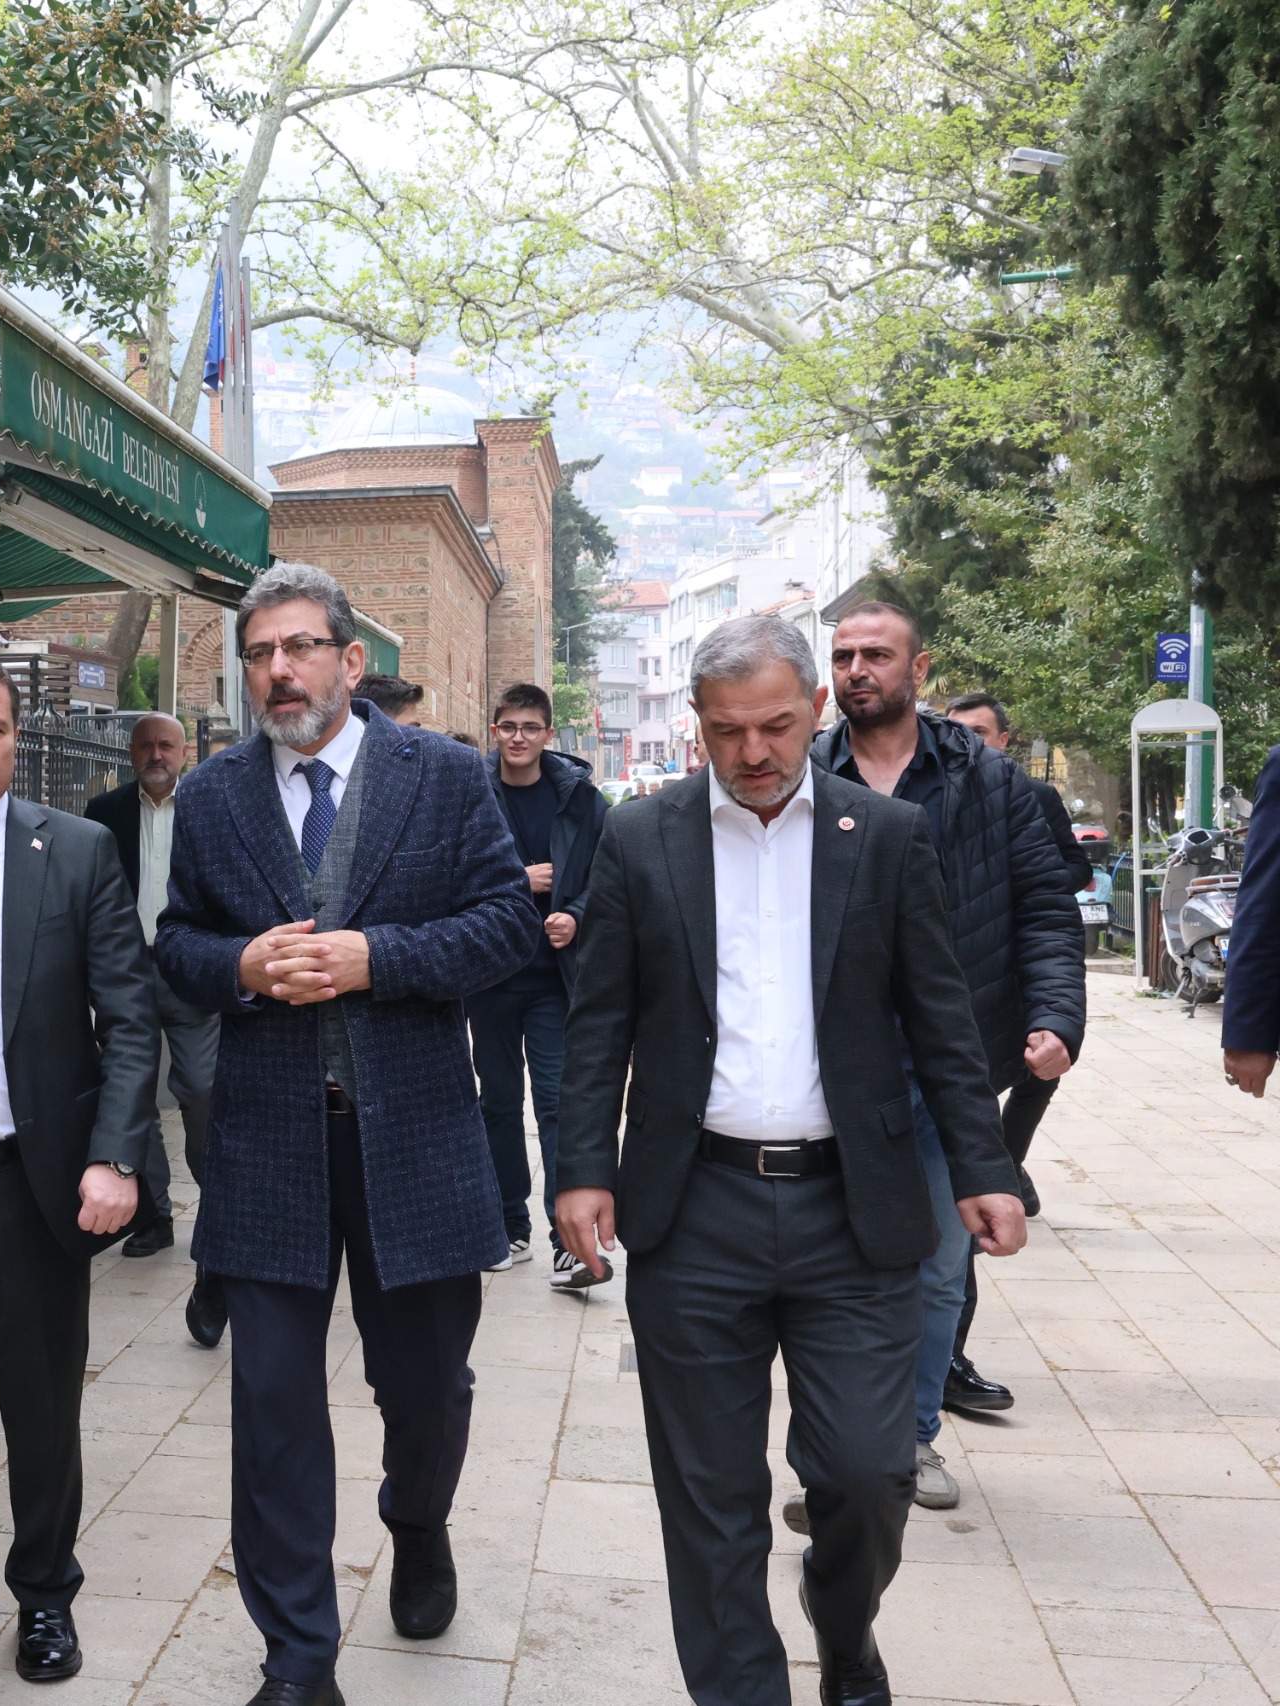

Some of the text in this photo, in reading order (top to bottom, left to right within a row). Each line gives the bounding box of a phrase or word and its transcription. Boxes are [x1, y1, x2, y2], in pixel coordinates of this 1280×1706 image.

[30, 371, 114, 465] OSMANGAZİ
[122, 431, 180, 505] BELEDİYESİ
[1084, 912, 1101, 920] 675
